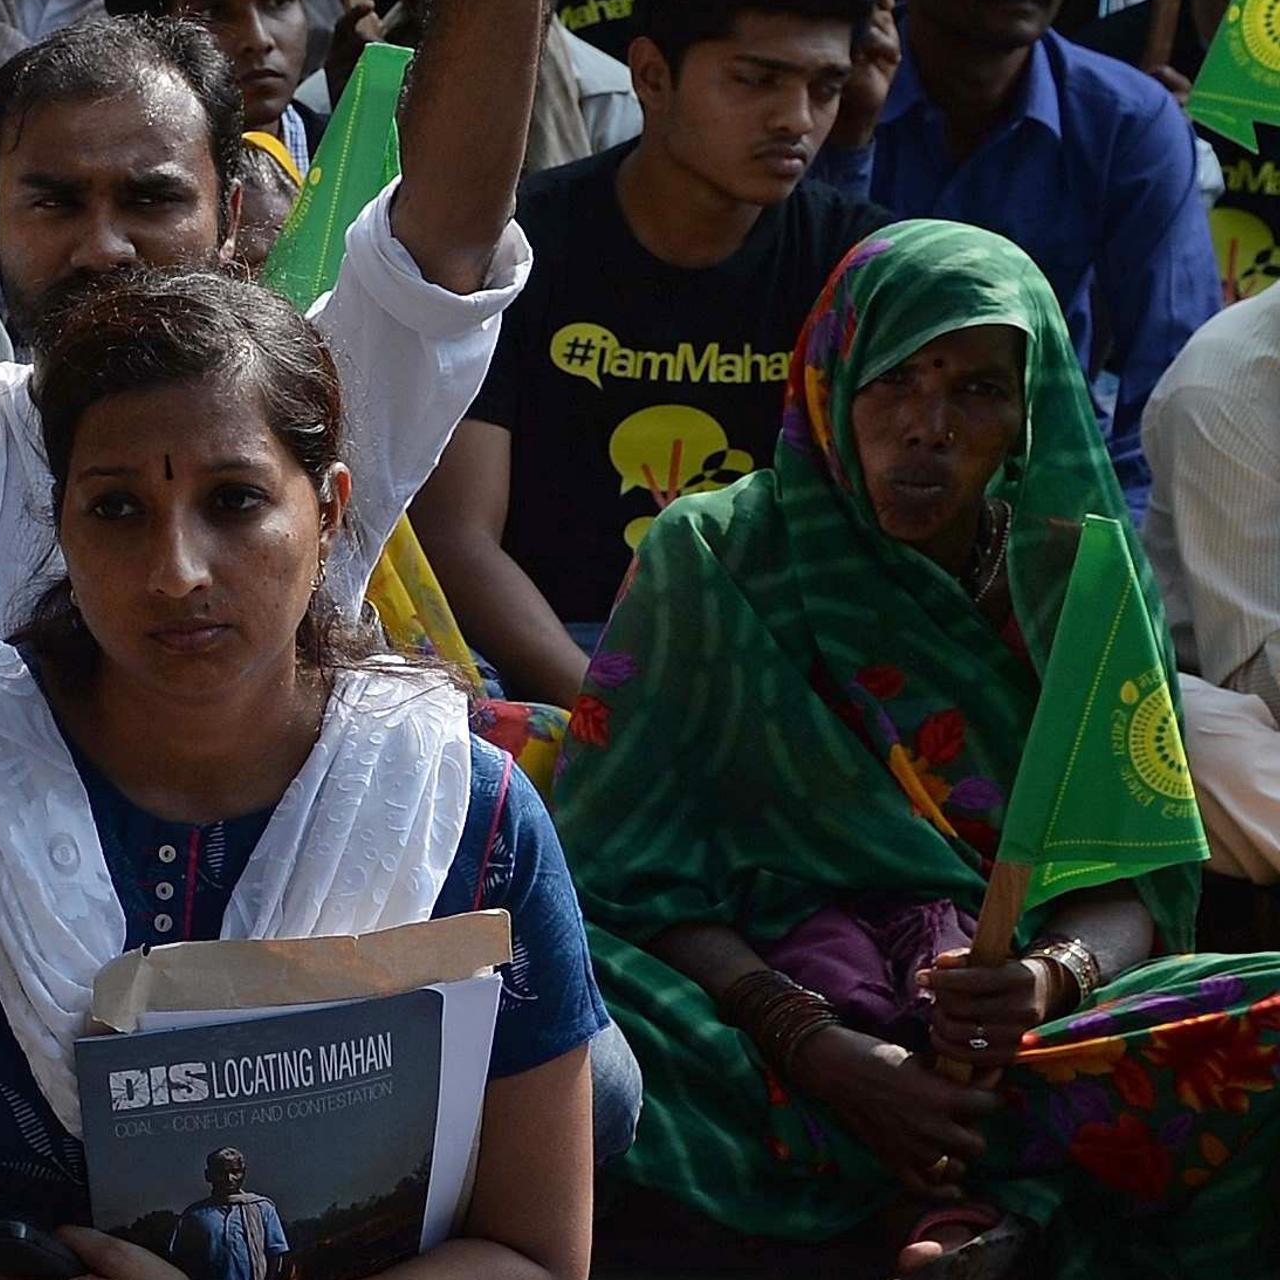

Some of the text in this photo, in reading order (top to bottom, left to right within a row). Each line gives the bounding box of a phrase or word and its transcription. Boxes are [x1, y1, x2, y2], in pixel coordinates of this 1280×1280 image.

[562, 335, 795, 384] #iamMaha
[320, 1031, 392, 1084] MAHAN
[251, 1104, 284, 1125] AND
